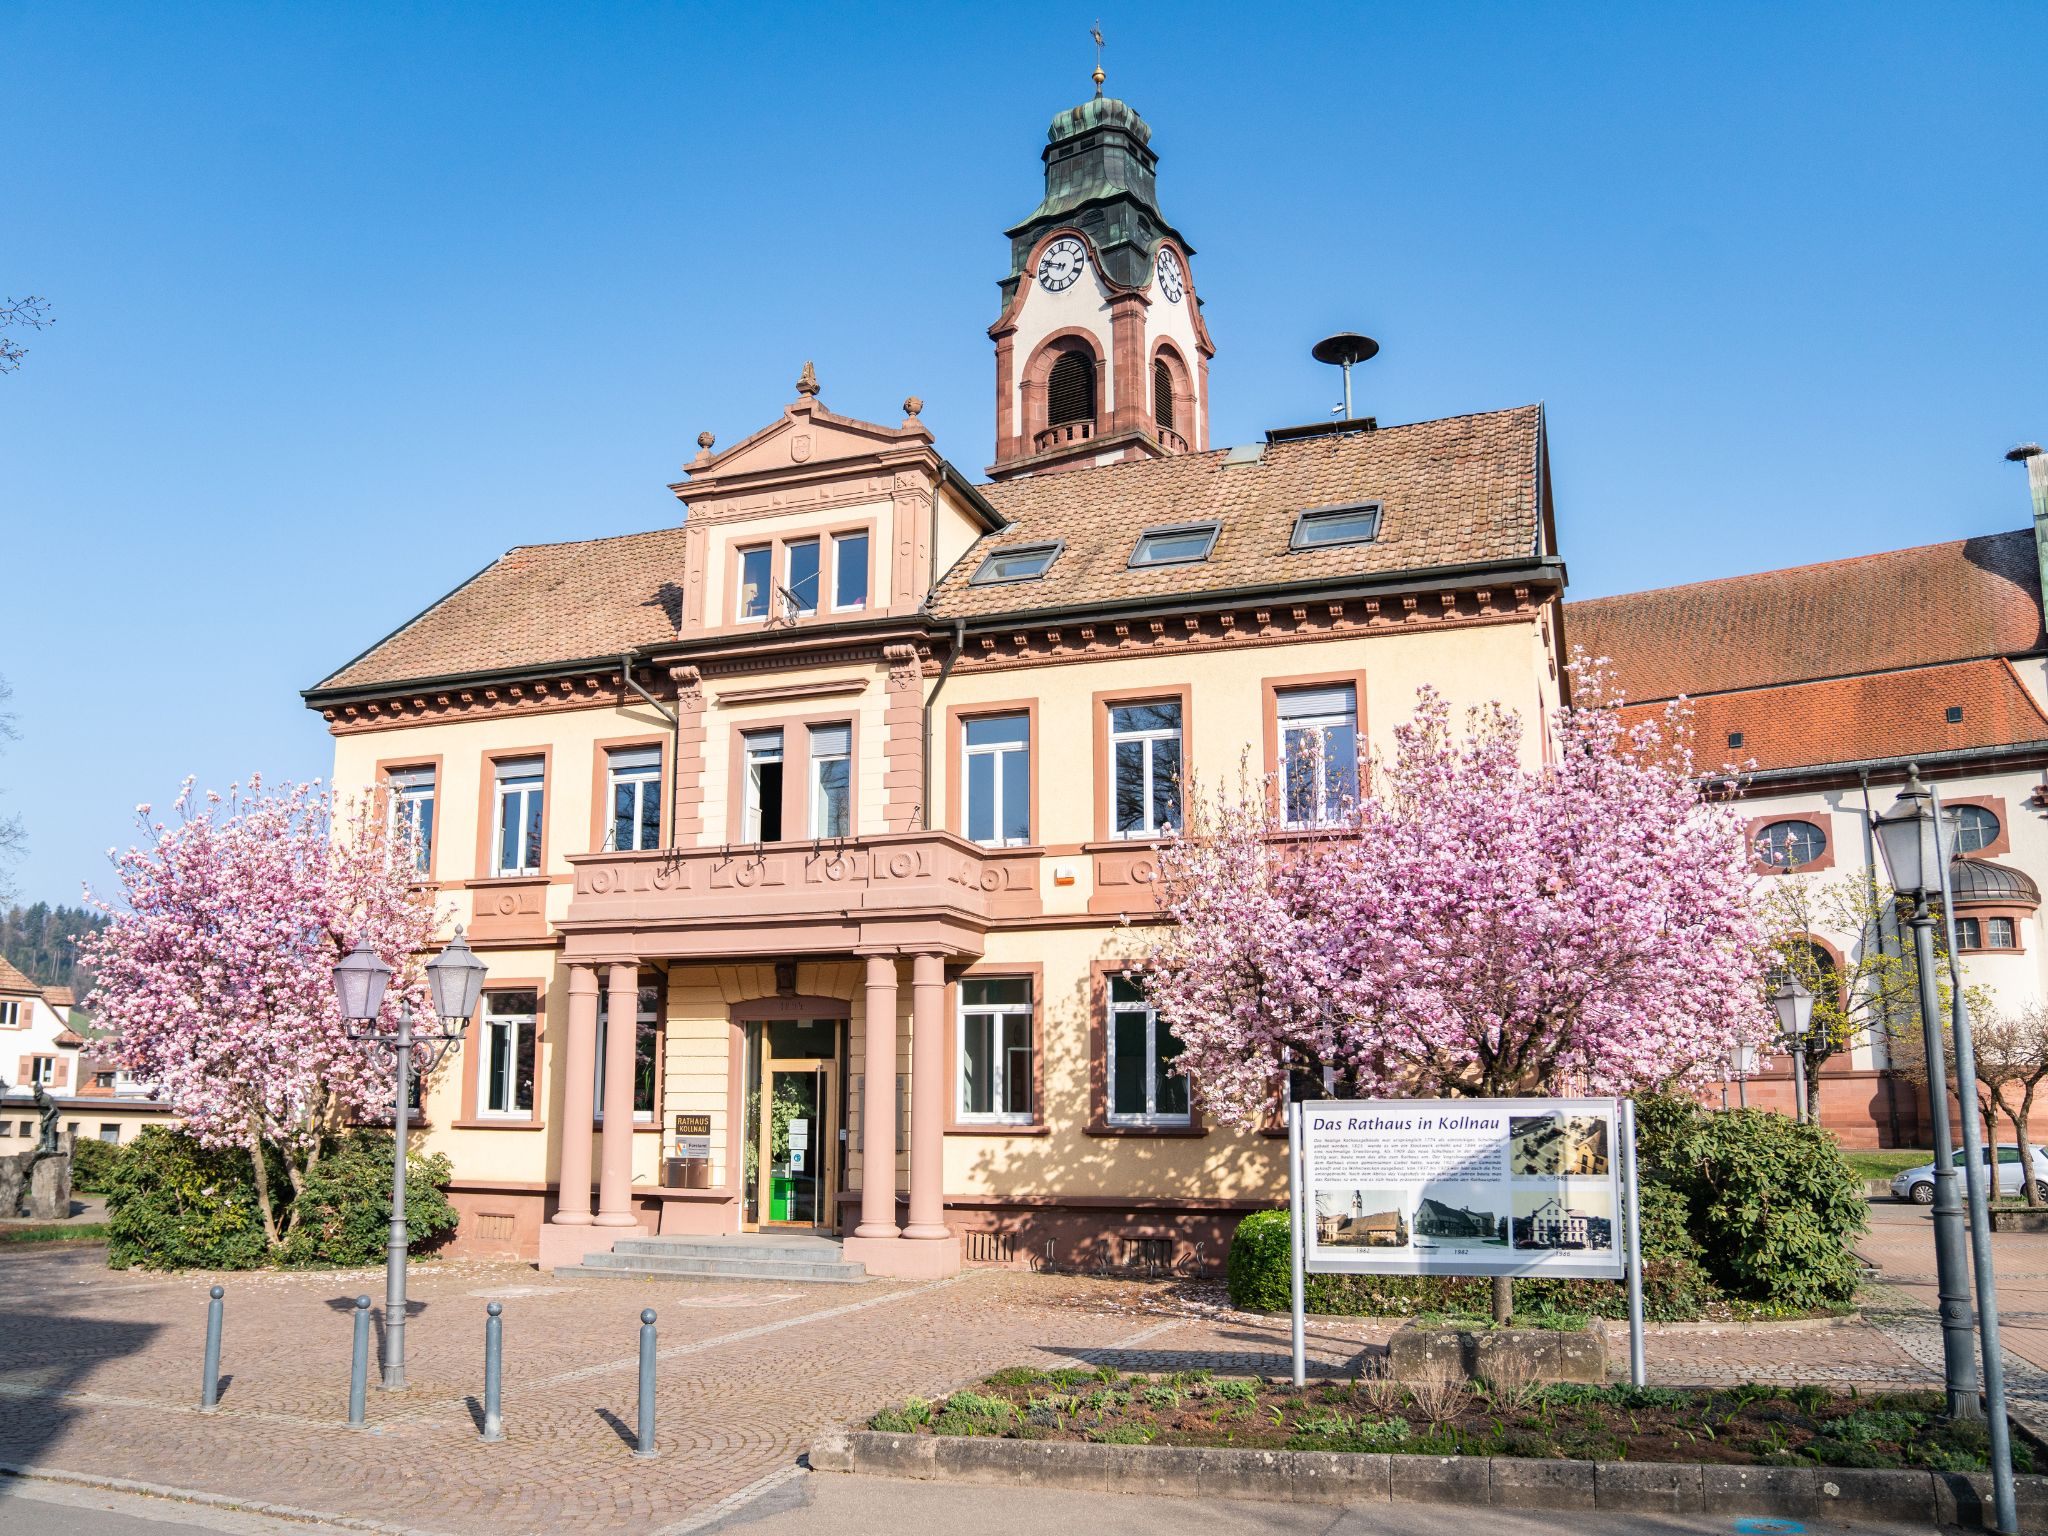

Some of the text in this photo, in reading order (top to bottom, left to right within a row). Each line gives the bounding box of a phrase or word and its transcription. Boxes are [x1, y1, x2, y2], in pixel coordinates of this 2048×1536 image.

[677, 1117, 709, 1125] RATHAUS
[1313, 1116, 1500, 1131] Das Rathaus in Kollnau
[679, 1125, 707, 1133] KOLLNAU
